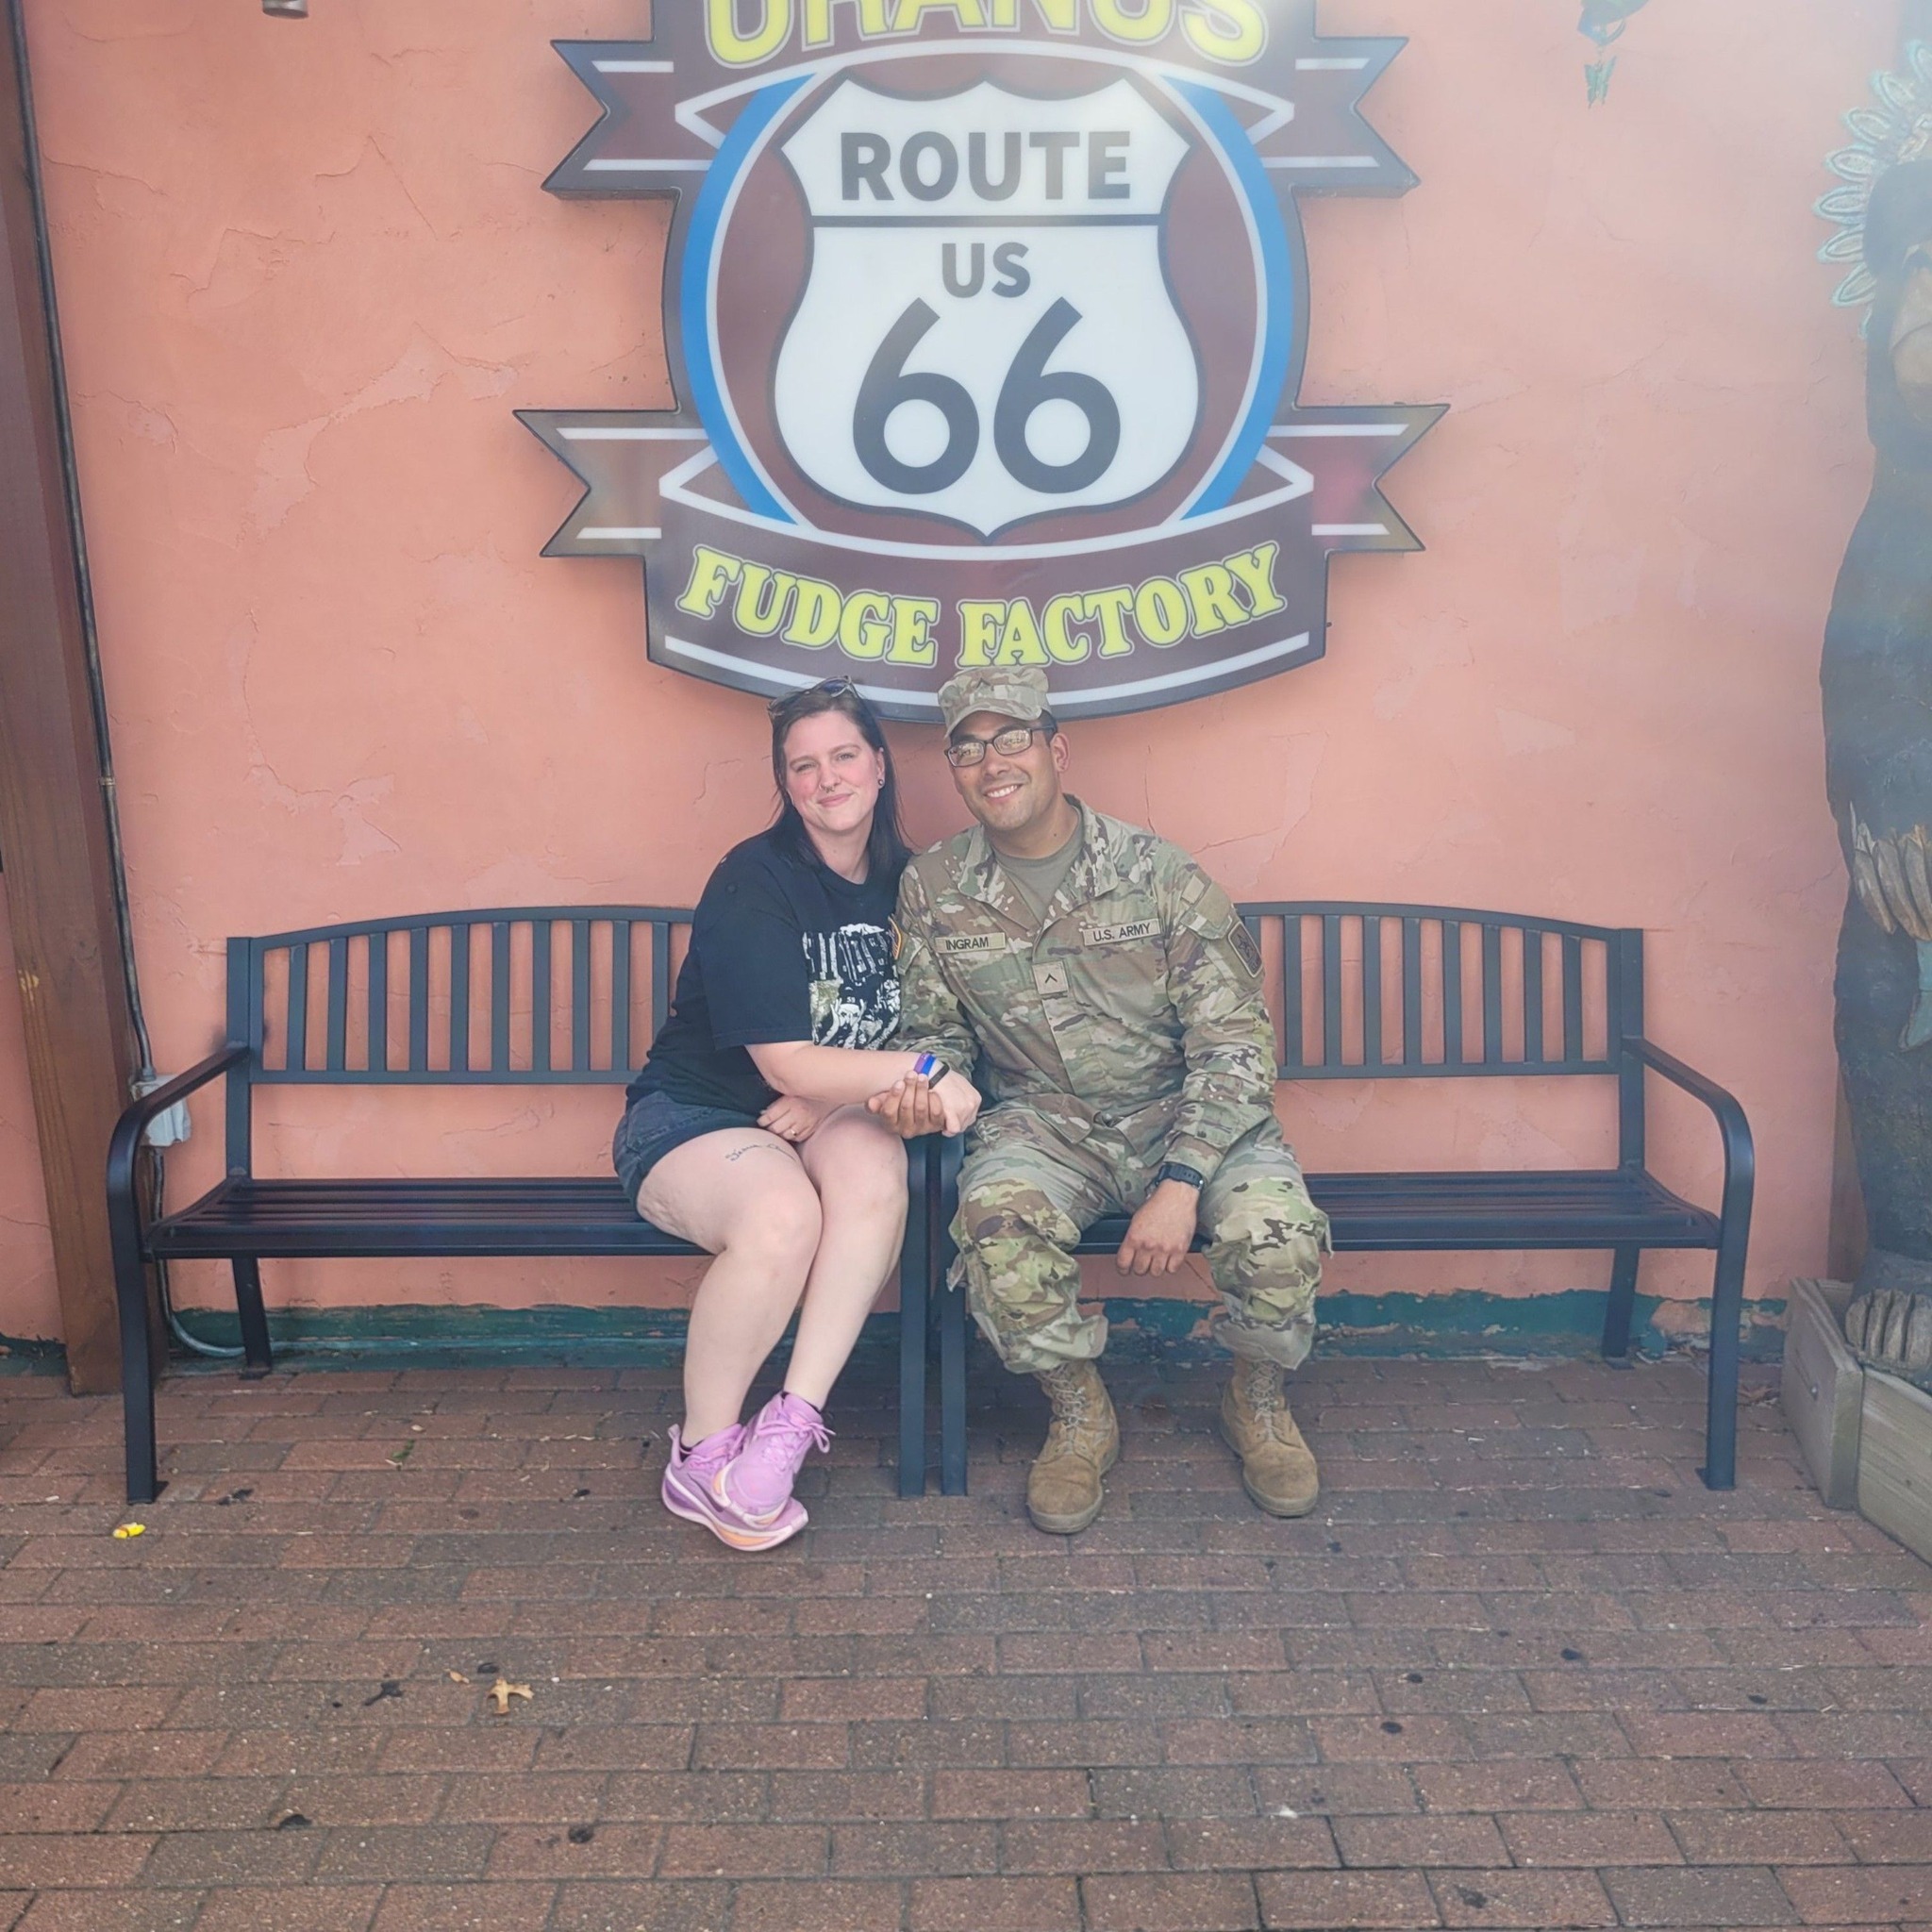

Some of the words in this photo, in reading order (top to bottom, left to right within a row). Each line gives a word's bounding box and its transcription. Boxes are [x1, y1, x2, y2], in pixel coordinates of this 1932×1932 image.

[841, 130, 1131, 202] ROUTE
[941, 242, 1031, 299] US
[852, 296, 1121, 494] 66
[677, 544, 940, 667] FUDGE
[956, 541, 1286, 667] FACTORY
[945, 936, 990, 951] INGRAM
[1092, 929, 1115, 942] U.S.
[1119, 923, 1151, 939] ARMY
